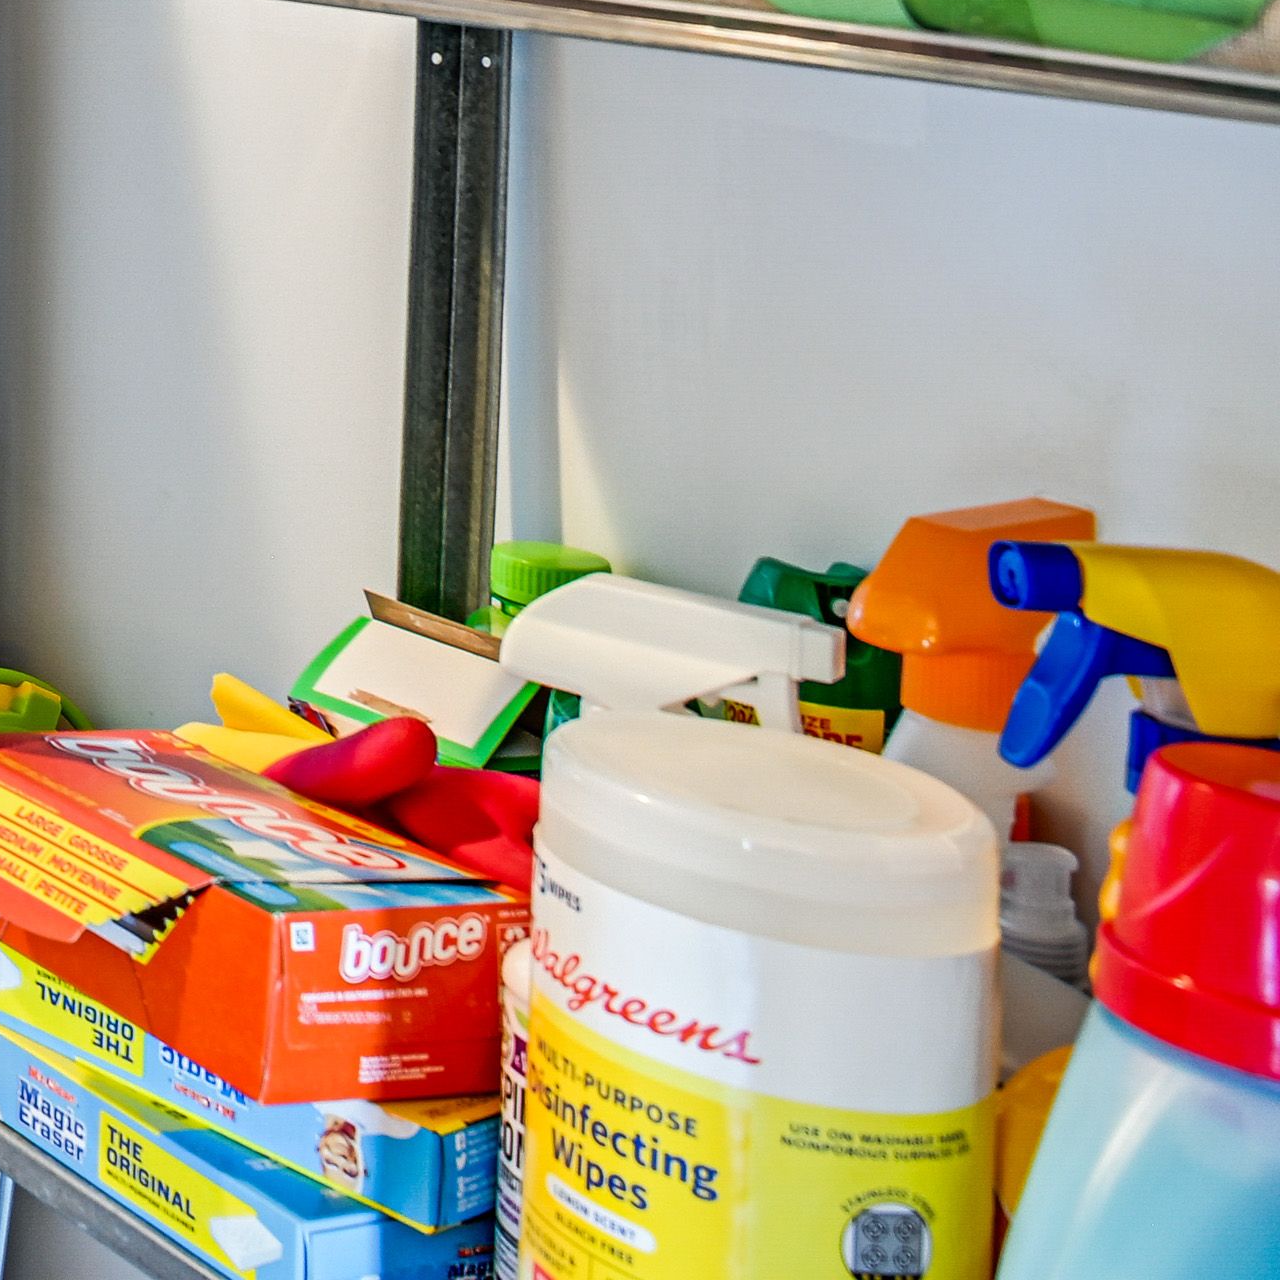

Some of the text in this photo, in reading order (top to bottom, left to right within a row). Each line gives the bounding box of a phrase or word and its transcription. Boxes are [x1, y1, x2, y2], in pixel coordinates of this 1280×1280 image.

[15, 805, 64, 838] LARGE
[68, 835, 129, 872] GROSSE
[34, 876, 88, 916] PETITE
[47, 853, 121, 901] MOYENNE
[548, 879, 582, 912] WIPES
[341, 914, 487, 982] bounce
[35, 980, 134, 1041] ORIGINAL
[92, 1028, 134, 1063] THE
[18, 1078, 85, 1140] Magic
[19, 1105, 85, 1161] Eraser
[107, 1124, 143, 1164] THE
[552, 1127, 648, 1210] Wipes
[107, 1147, 196, 1221] ORIGINAL
